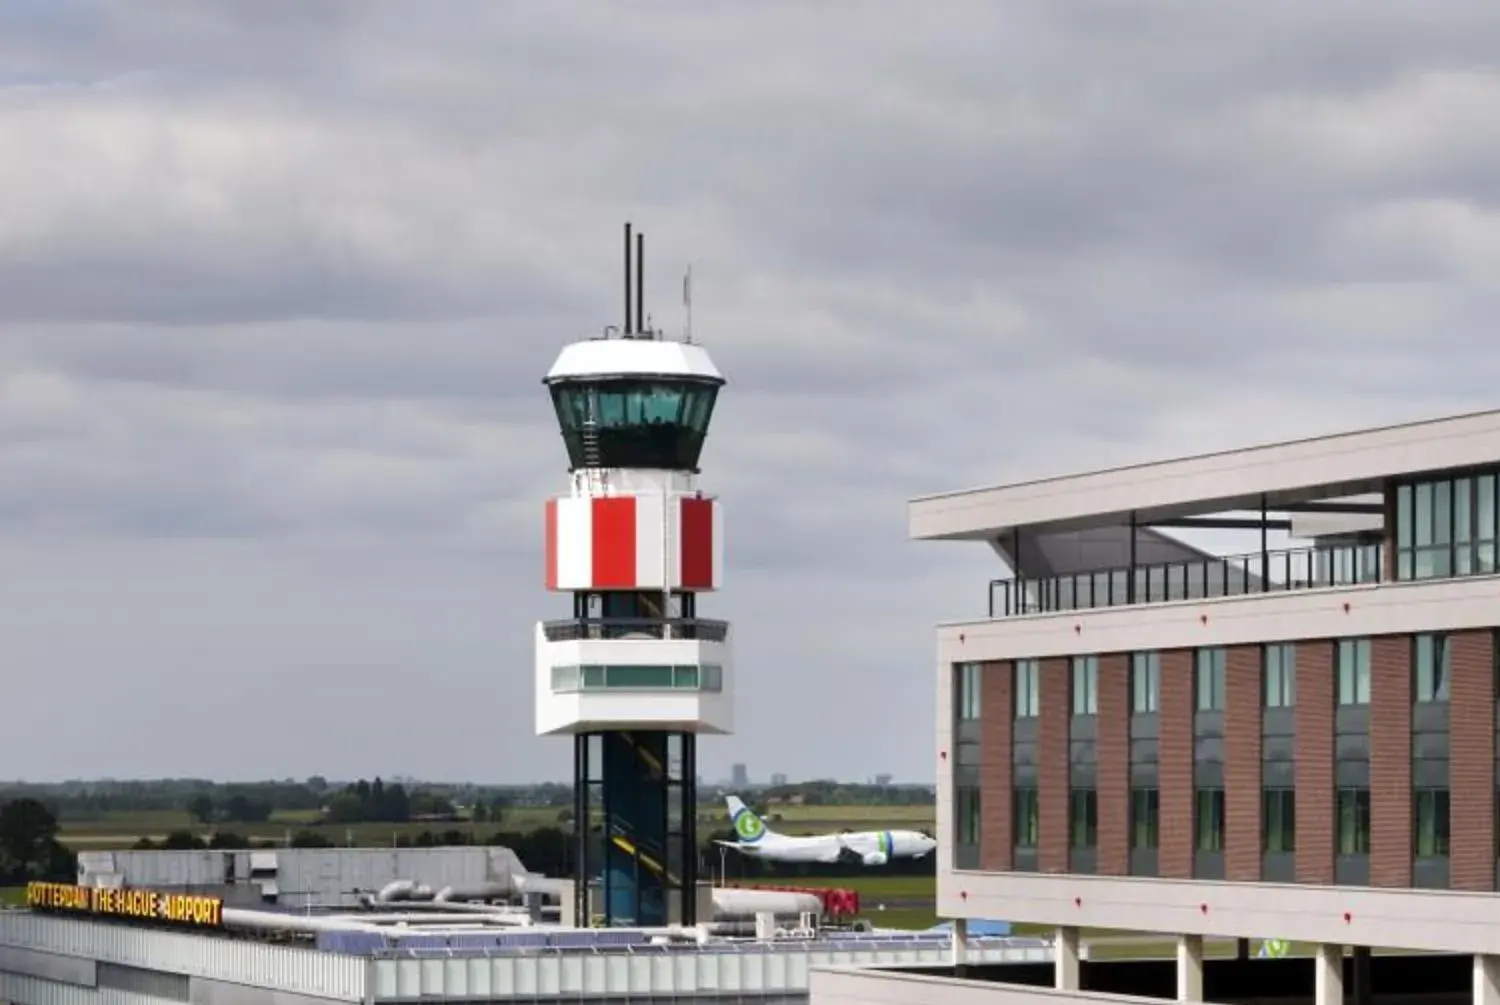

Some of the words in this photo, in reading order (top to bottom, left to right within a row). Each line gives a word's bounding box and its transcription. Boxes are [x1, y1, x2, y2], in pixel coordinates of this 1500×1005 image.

[92, 888, 114, 912] THE
[118, 889, 157, 917] HAGUE
[162, 894, 221, 924] AIRPORT
